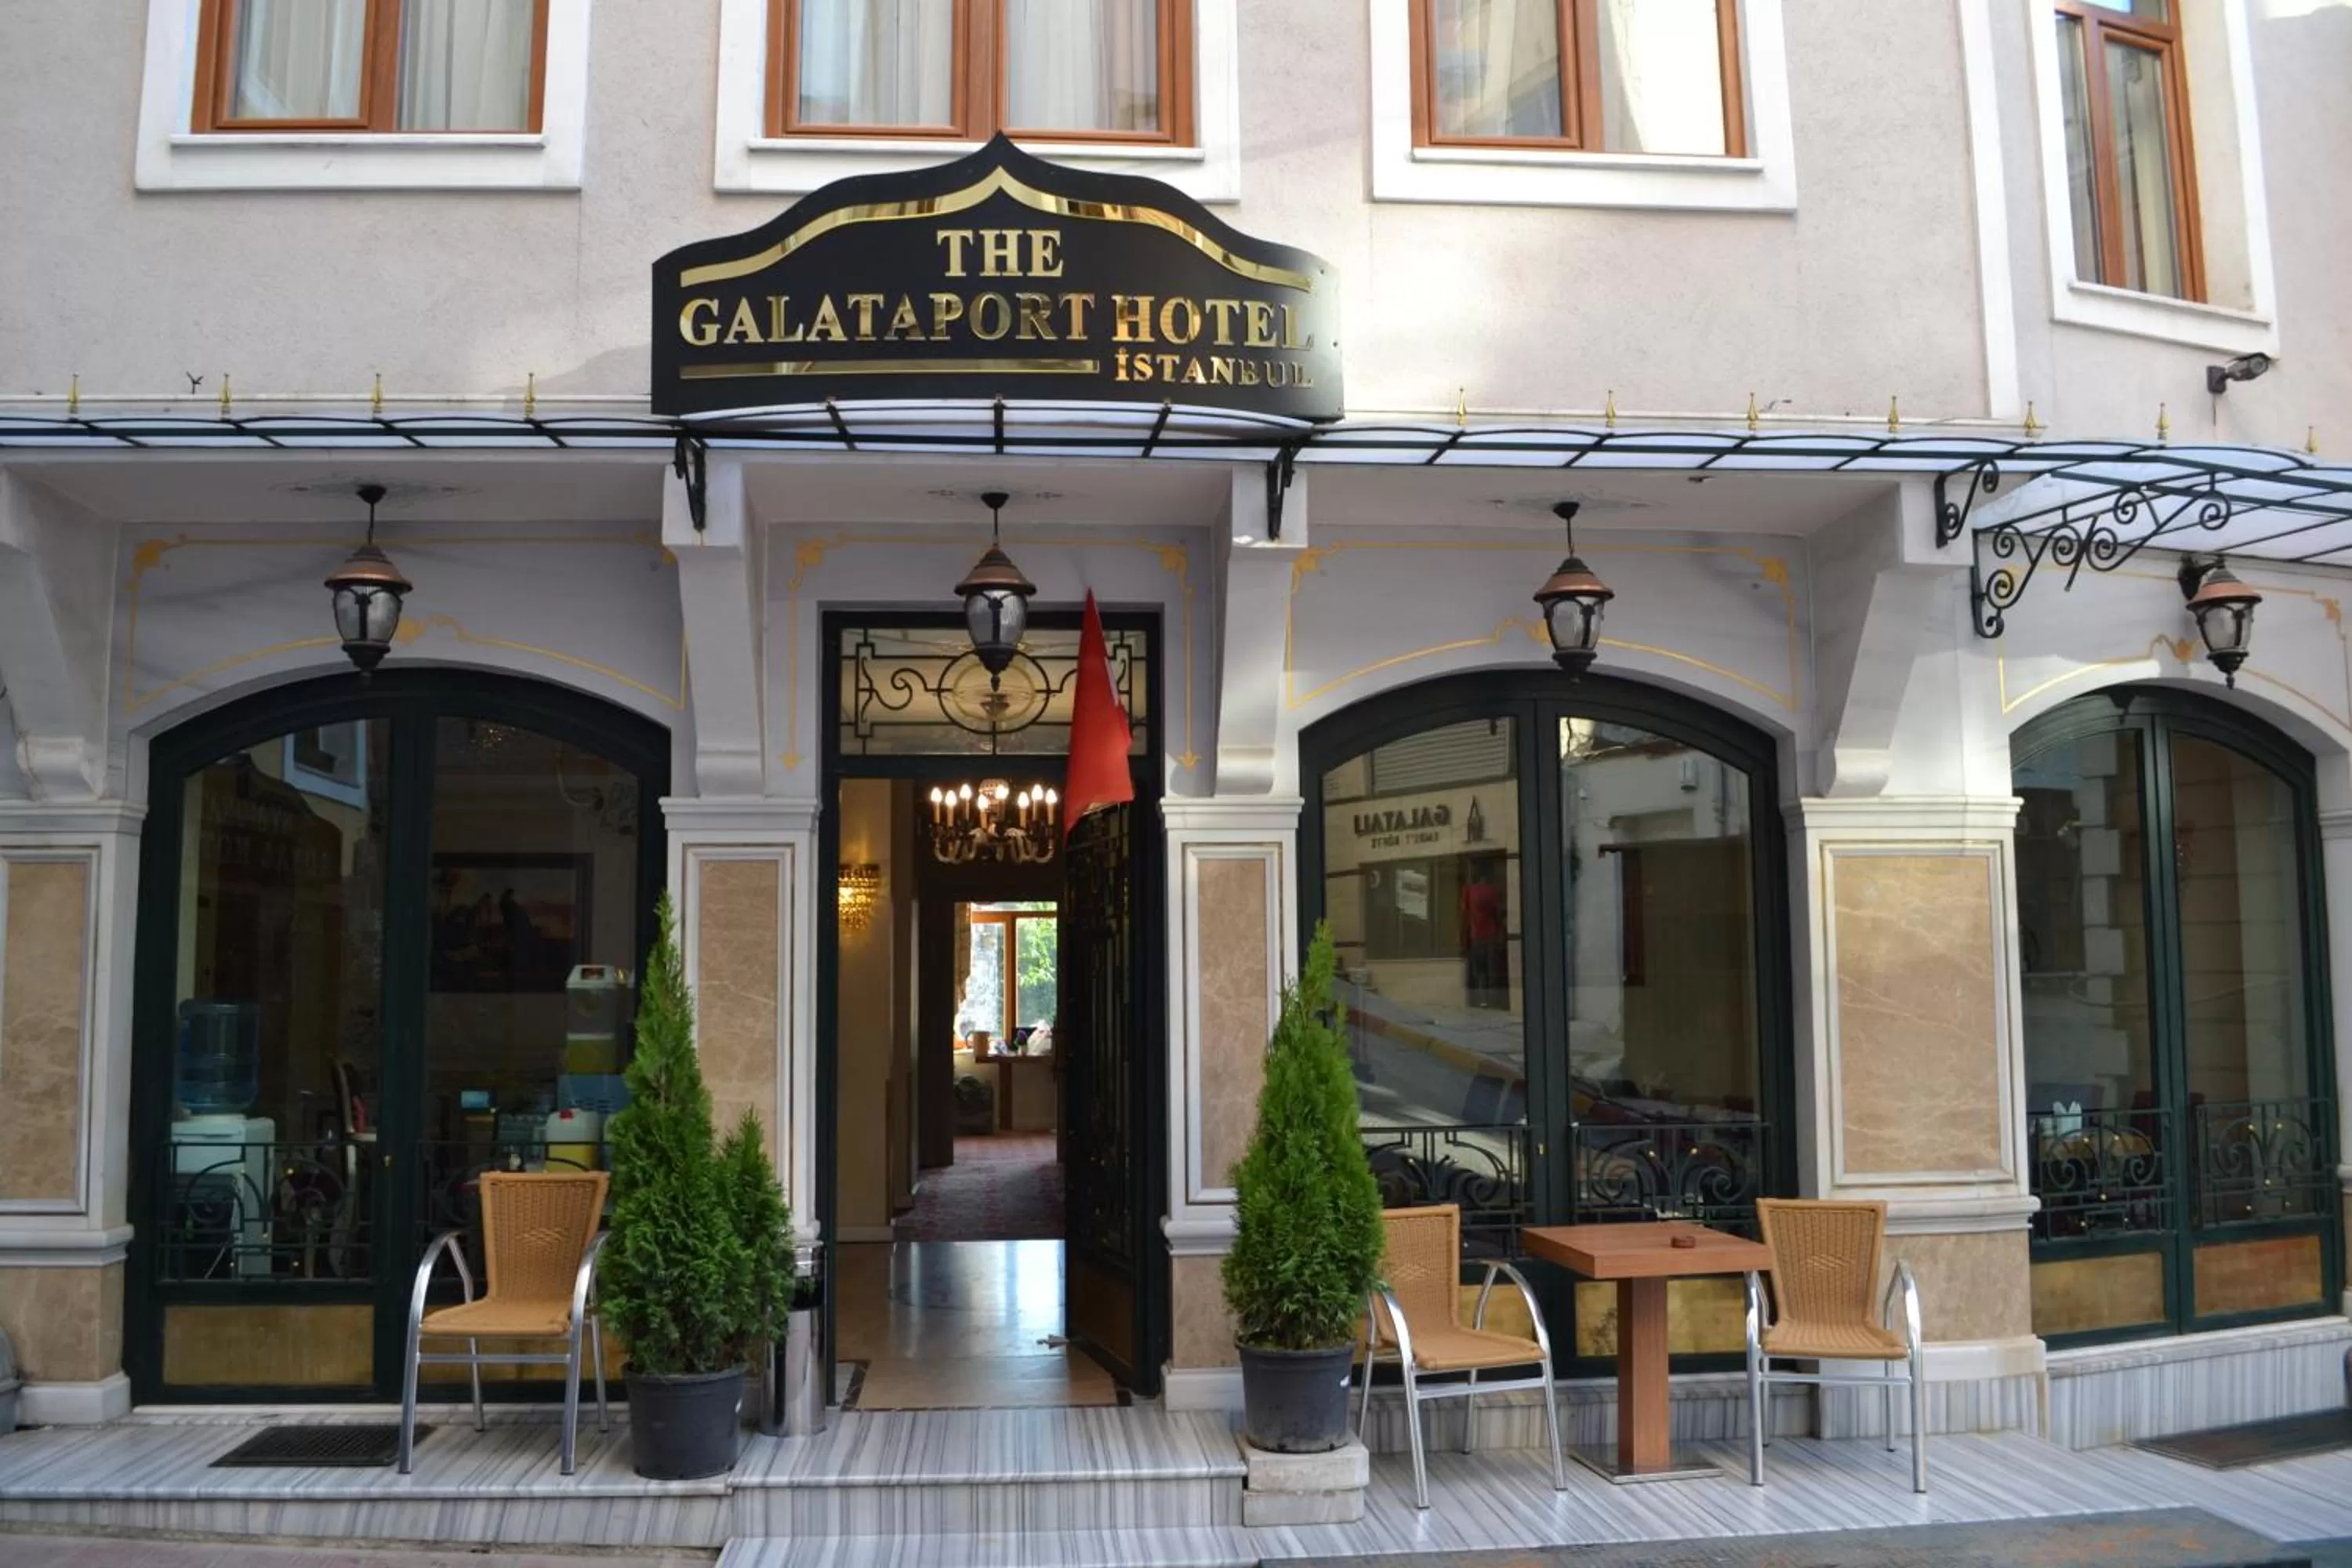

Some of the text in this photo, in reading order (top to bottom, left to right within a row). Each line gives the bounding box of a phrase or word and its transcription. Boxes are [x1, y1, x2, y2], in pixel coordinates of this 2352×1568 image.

[936, 229, 1064, 278] THE
[678, 292, 1315, 351] GALATAPORT HOTEL
[1114, 347, 1315, 389] İSTANBUL
